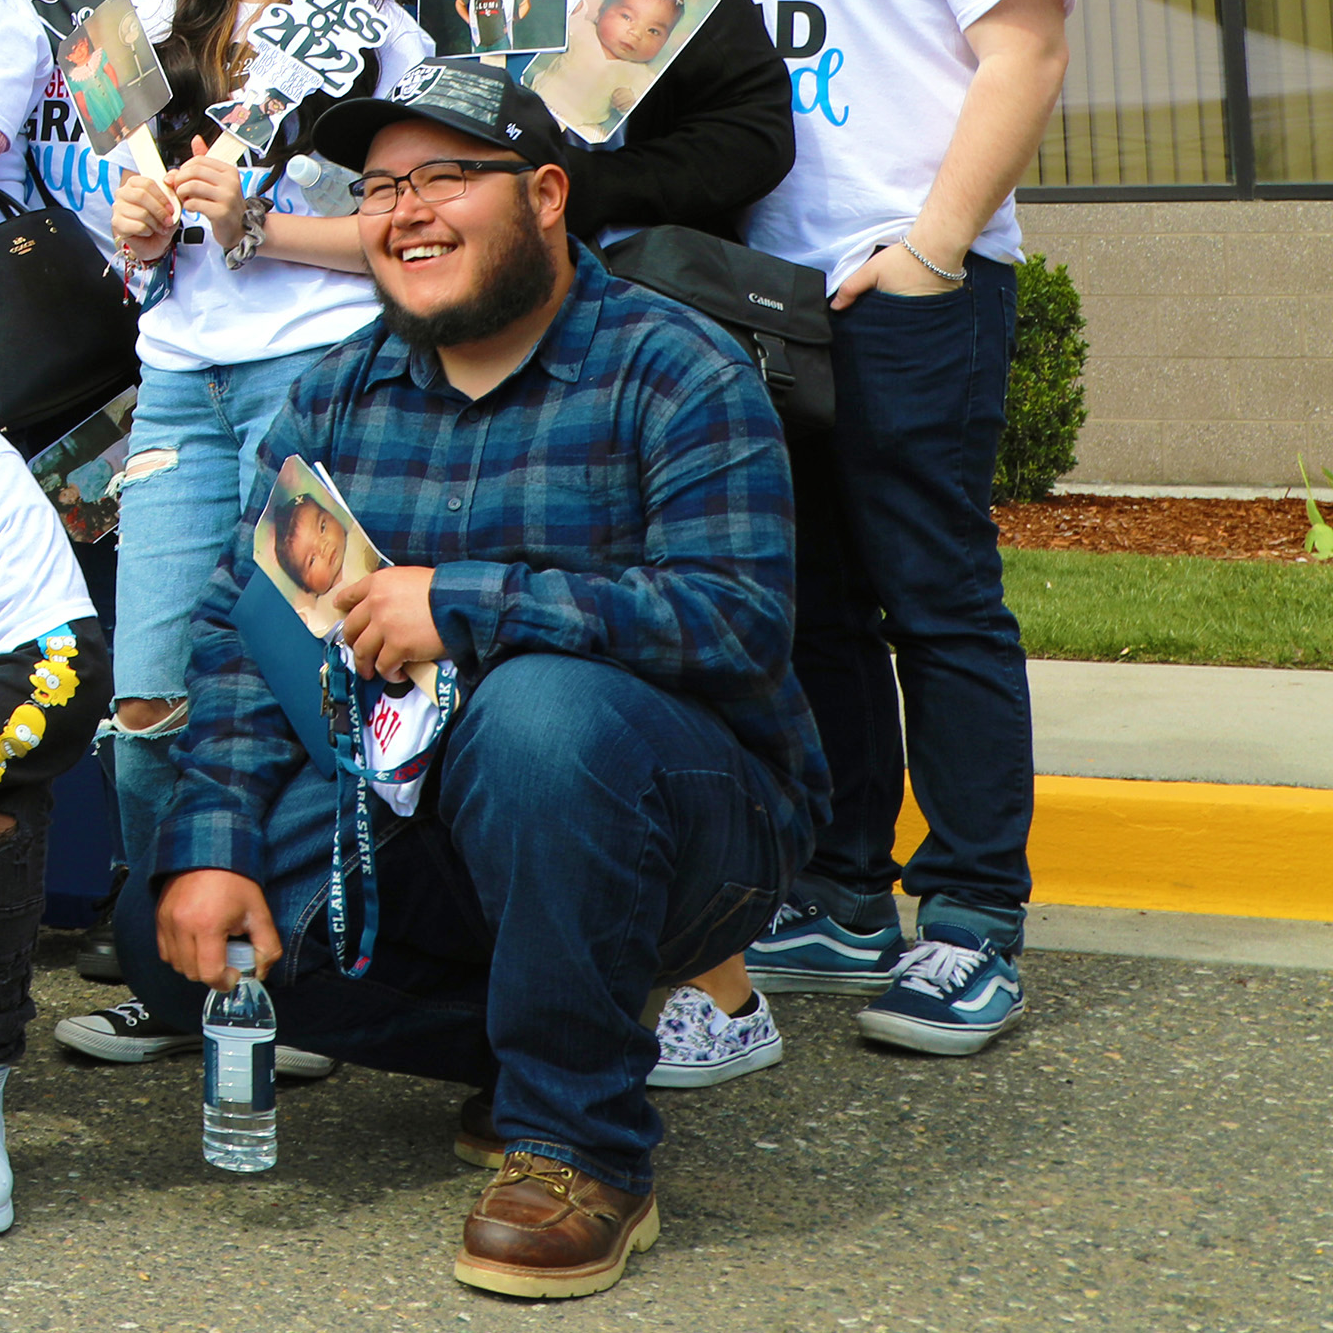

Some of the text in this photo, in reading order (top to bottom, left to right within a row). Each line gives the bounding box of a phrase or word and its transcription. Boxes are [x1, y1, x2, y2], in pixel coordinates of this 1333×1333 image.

[253, 7, 359, 91] 2022
[279, 79, 304, 100] GASTA
[748, 292, 784, 311] Canon
[357, 820, 373, 875] STATE
